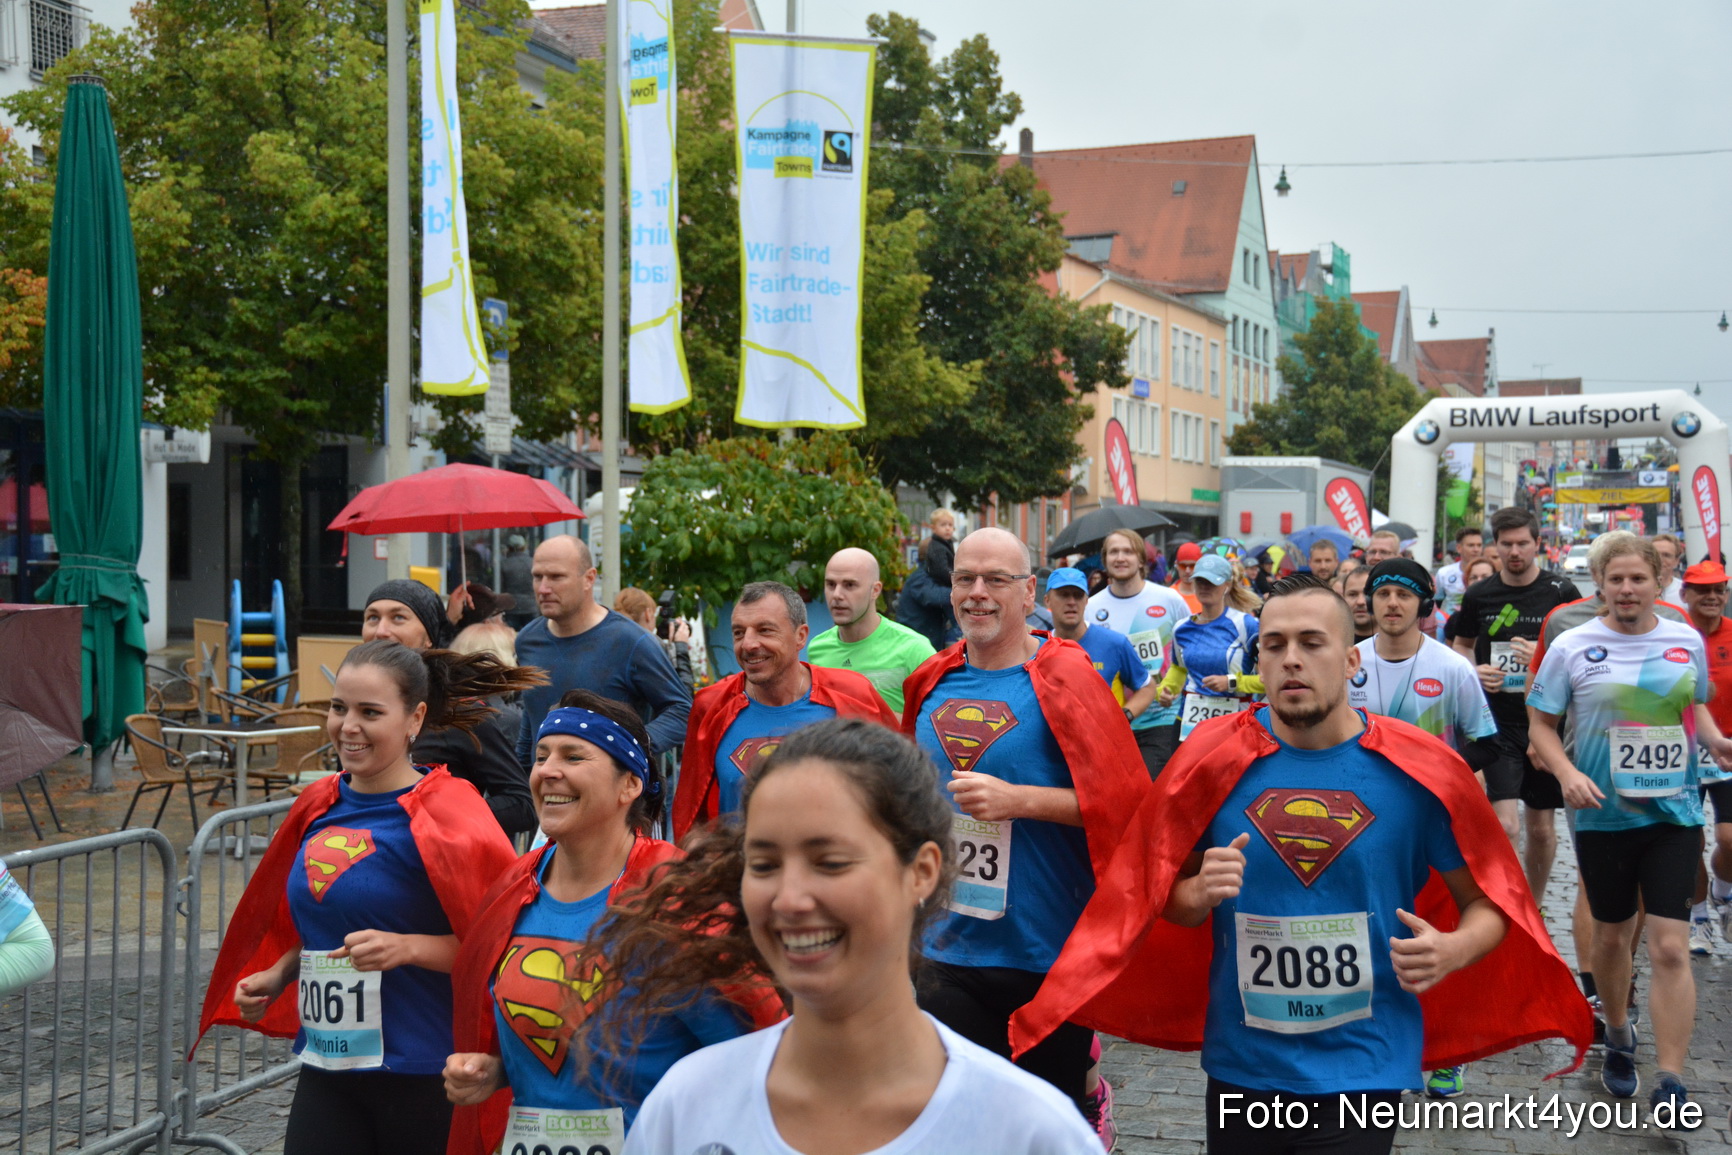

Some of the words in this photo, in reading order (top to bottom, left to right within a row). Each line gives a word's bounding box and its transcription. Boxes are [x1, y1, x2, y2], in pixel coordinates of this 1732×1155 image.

[747, 129, 811, 142] Kampagne
[747, 140, 817, 156] Fairtrade
[776, 162, 812, 173] Towns
[746, 241, 783, 262] Wir
[789, 241, 830, 265] sind
[748, 272, 851, 296] Fairtrade-
[752, 303, 812, 324] Stadt!
[1450, 407, 1521, 428] BMW
[1529, 402, 1661, 429] Laufsport
[1600, 491, 1625, 501] ZIEL
[1696, 474, 1718, 539] REWE
[1508, 677, 1524, 686] Dan
[1188, 706, 1232, 723] 236
[1619, 743, 1683, 770] 2492
[1700, 747, 1712, 764] 2
[1634, 776, 1669, 787] Florian
[959, 840, 999, 881] 23
[1245, 927, 1283, 937] NeuerMarkt
[1290, 917, 1356, 935] BOCK
[1250, 943, 1361, 989] 2088
[301, 979, 365, 1024] 2061
[1287, 1000, 1325, 1018] Max
[546, 1114, 610, 1132] BOCK
